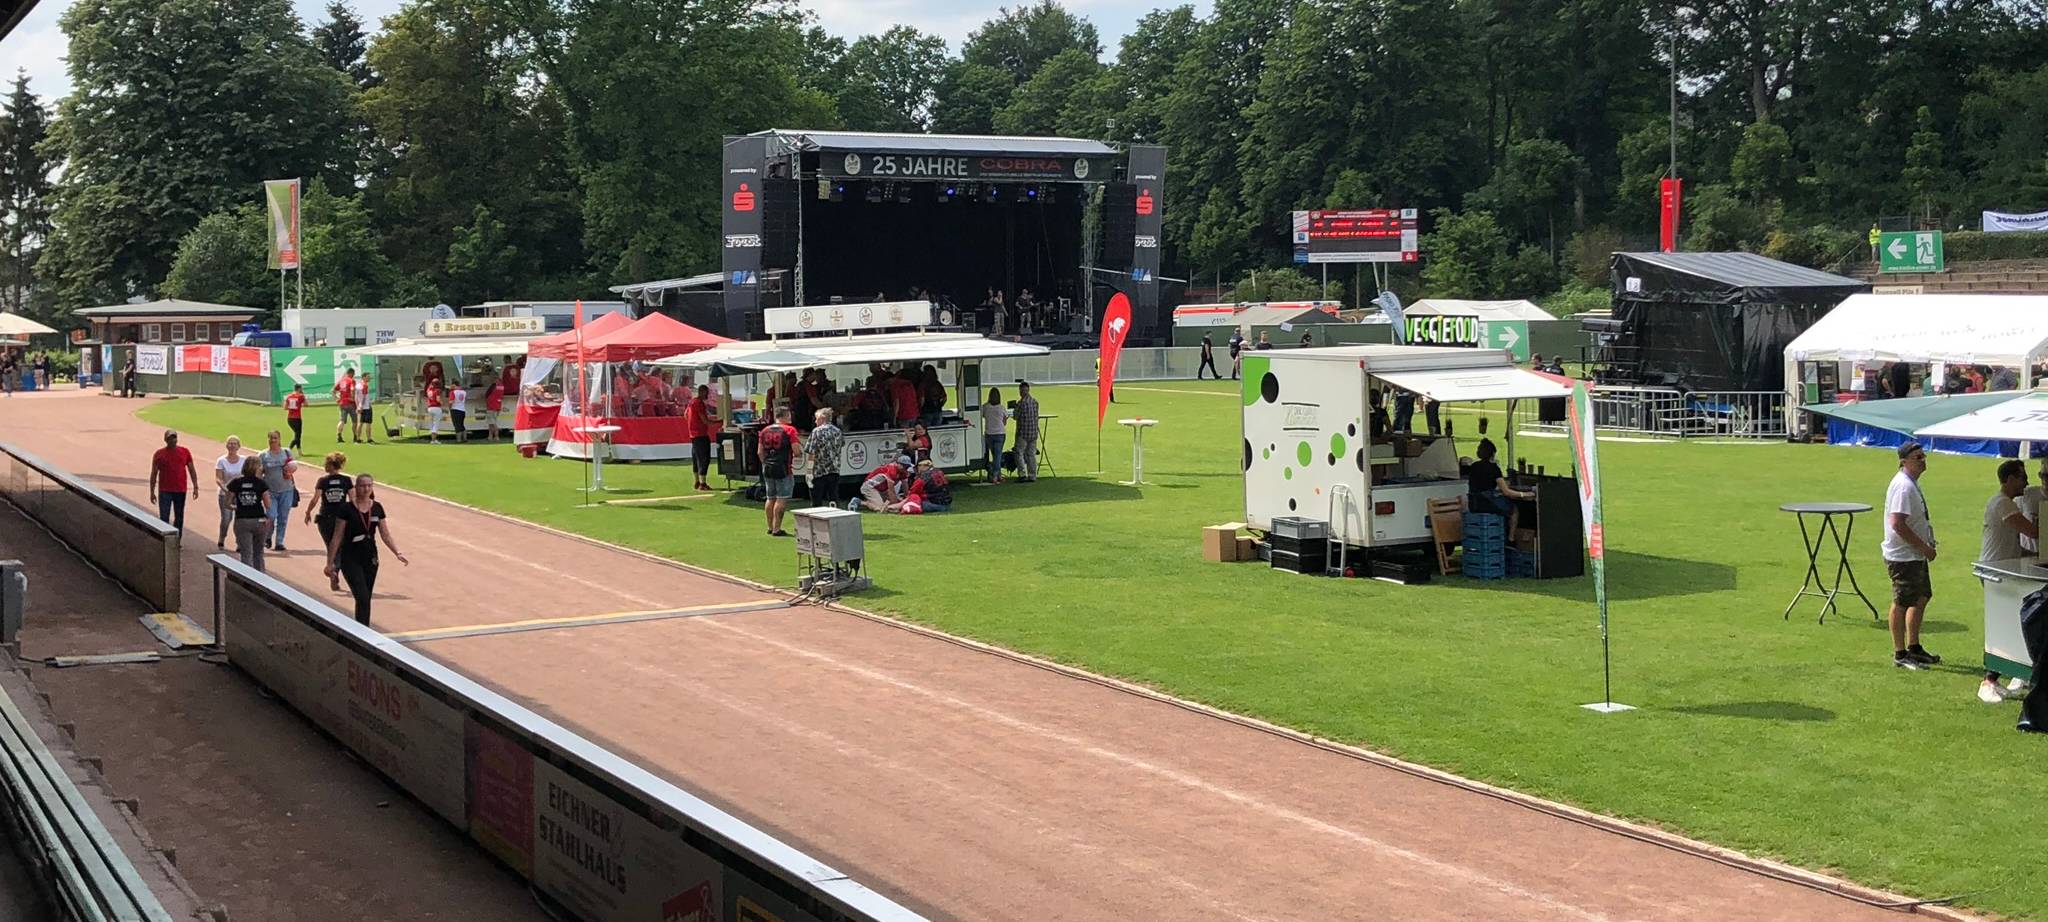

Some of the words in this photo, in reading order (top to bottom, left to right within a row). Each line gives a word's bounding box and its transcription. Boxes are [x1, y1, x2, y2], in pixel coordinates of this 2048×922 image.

[873, 155, 897, 174] 25
[902, 157, 968, 176] JAHRE
[979, 158, 1062, 171] COBRA
[502, 320, 527, 330] Pils
[1405, 316, 1478, 343] VEGGIEFOOD
[347, 658, 401, 721] EMONS
[548, 782, 612, 844] EICHNER
[538, 813, 627, 894] STAHLHAUS
